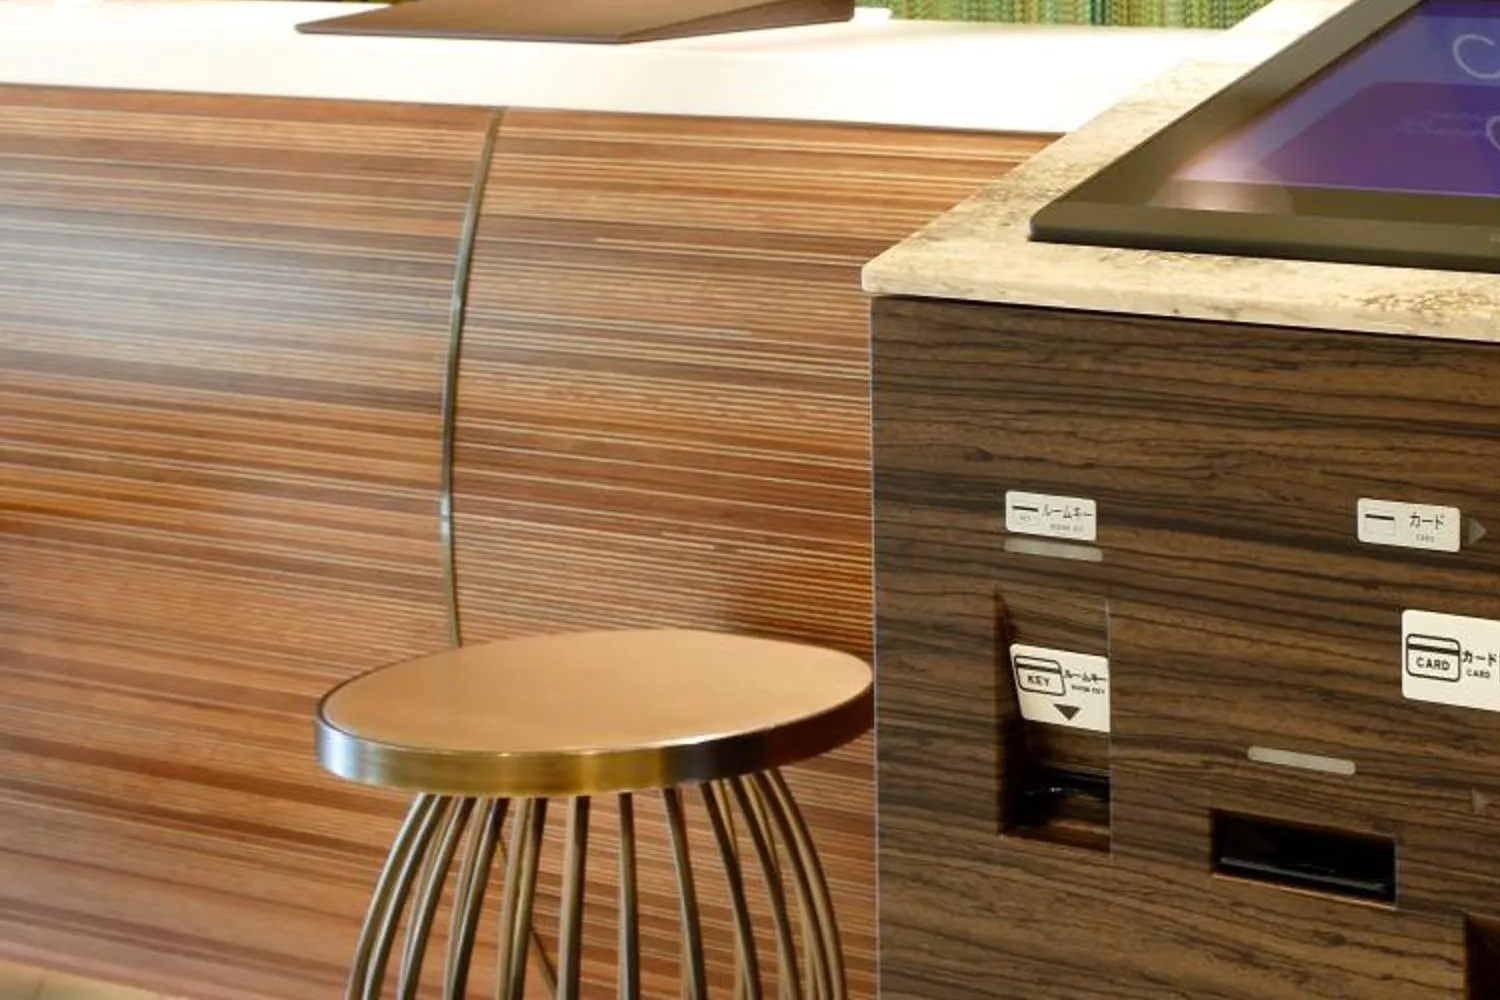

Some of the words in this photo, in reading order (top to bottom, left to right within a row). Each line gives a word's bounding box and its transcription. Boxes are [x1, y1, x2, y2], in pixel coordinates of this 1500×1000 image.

[1409, 511, 1445, 531] カード
[1416, 657, 1451, 671] CARD
[1462, 650, 1497, 667] カード
[1027, 675, 1050, 687] KEY
[1466, 669, 1491, 679] CARD
